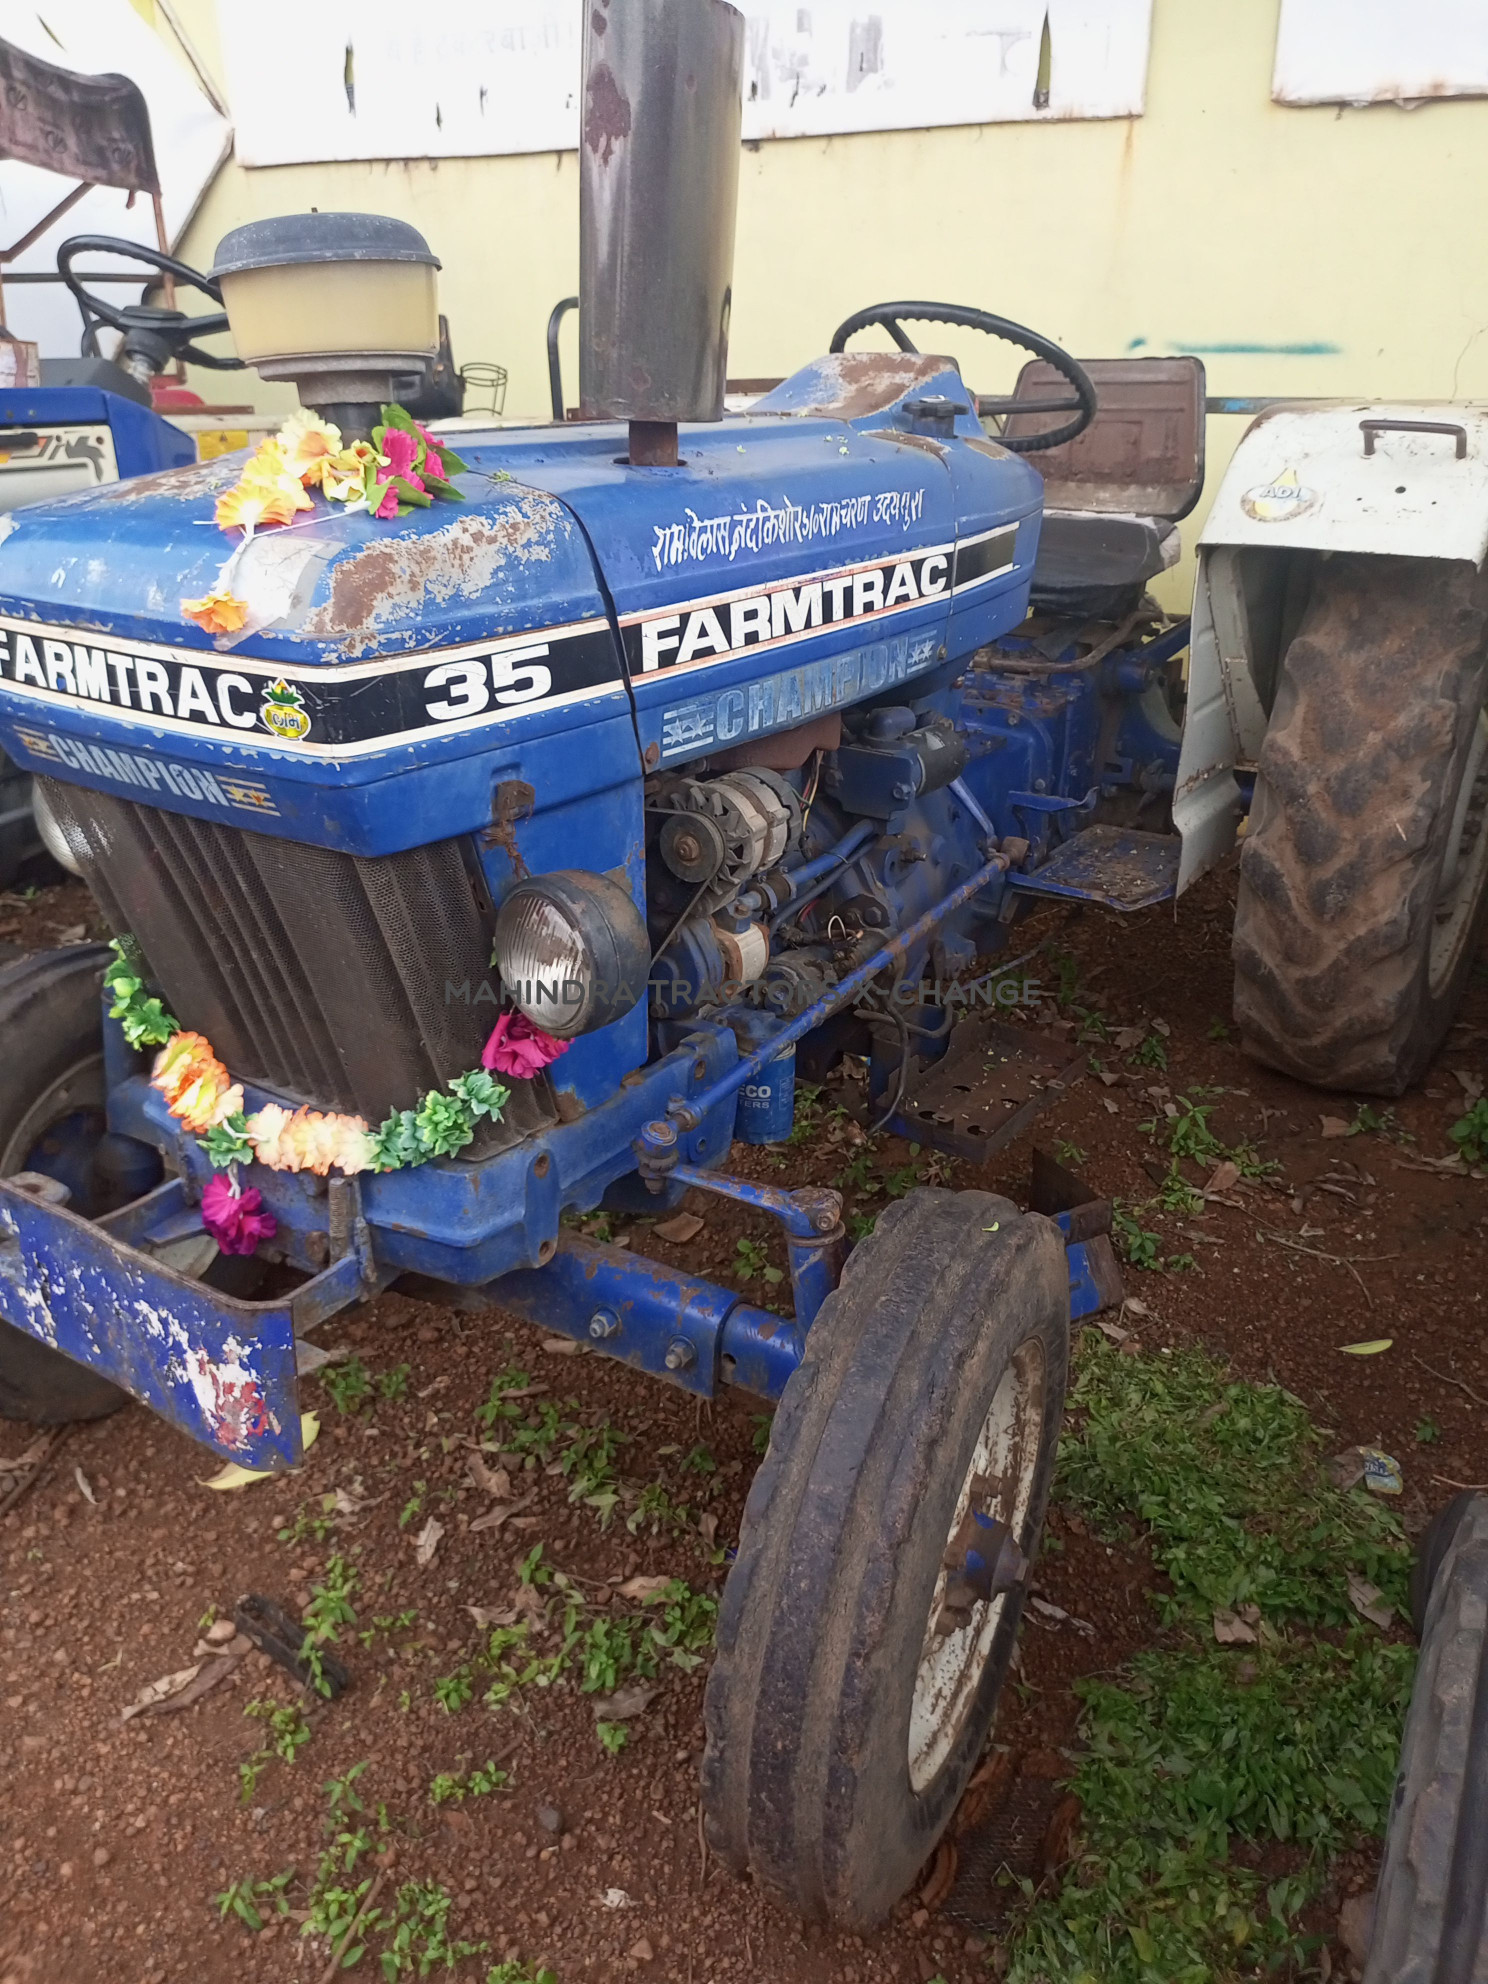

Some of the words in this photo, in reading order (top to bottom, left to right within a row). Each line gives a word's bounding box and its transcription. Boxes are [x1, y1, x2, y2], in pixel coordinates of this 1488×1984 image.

[642, 554, 948, 672] FARMTRAC
[424, 644, 552, 720] 35
[716, 637, 908, 740] CHAMPION
[48, 733, 230, 807] CHAMPION
